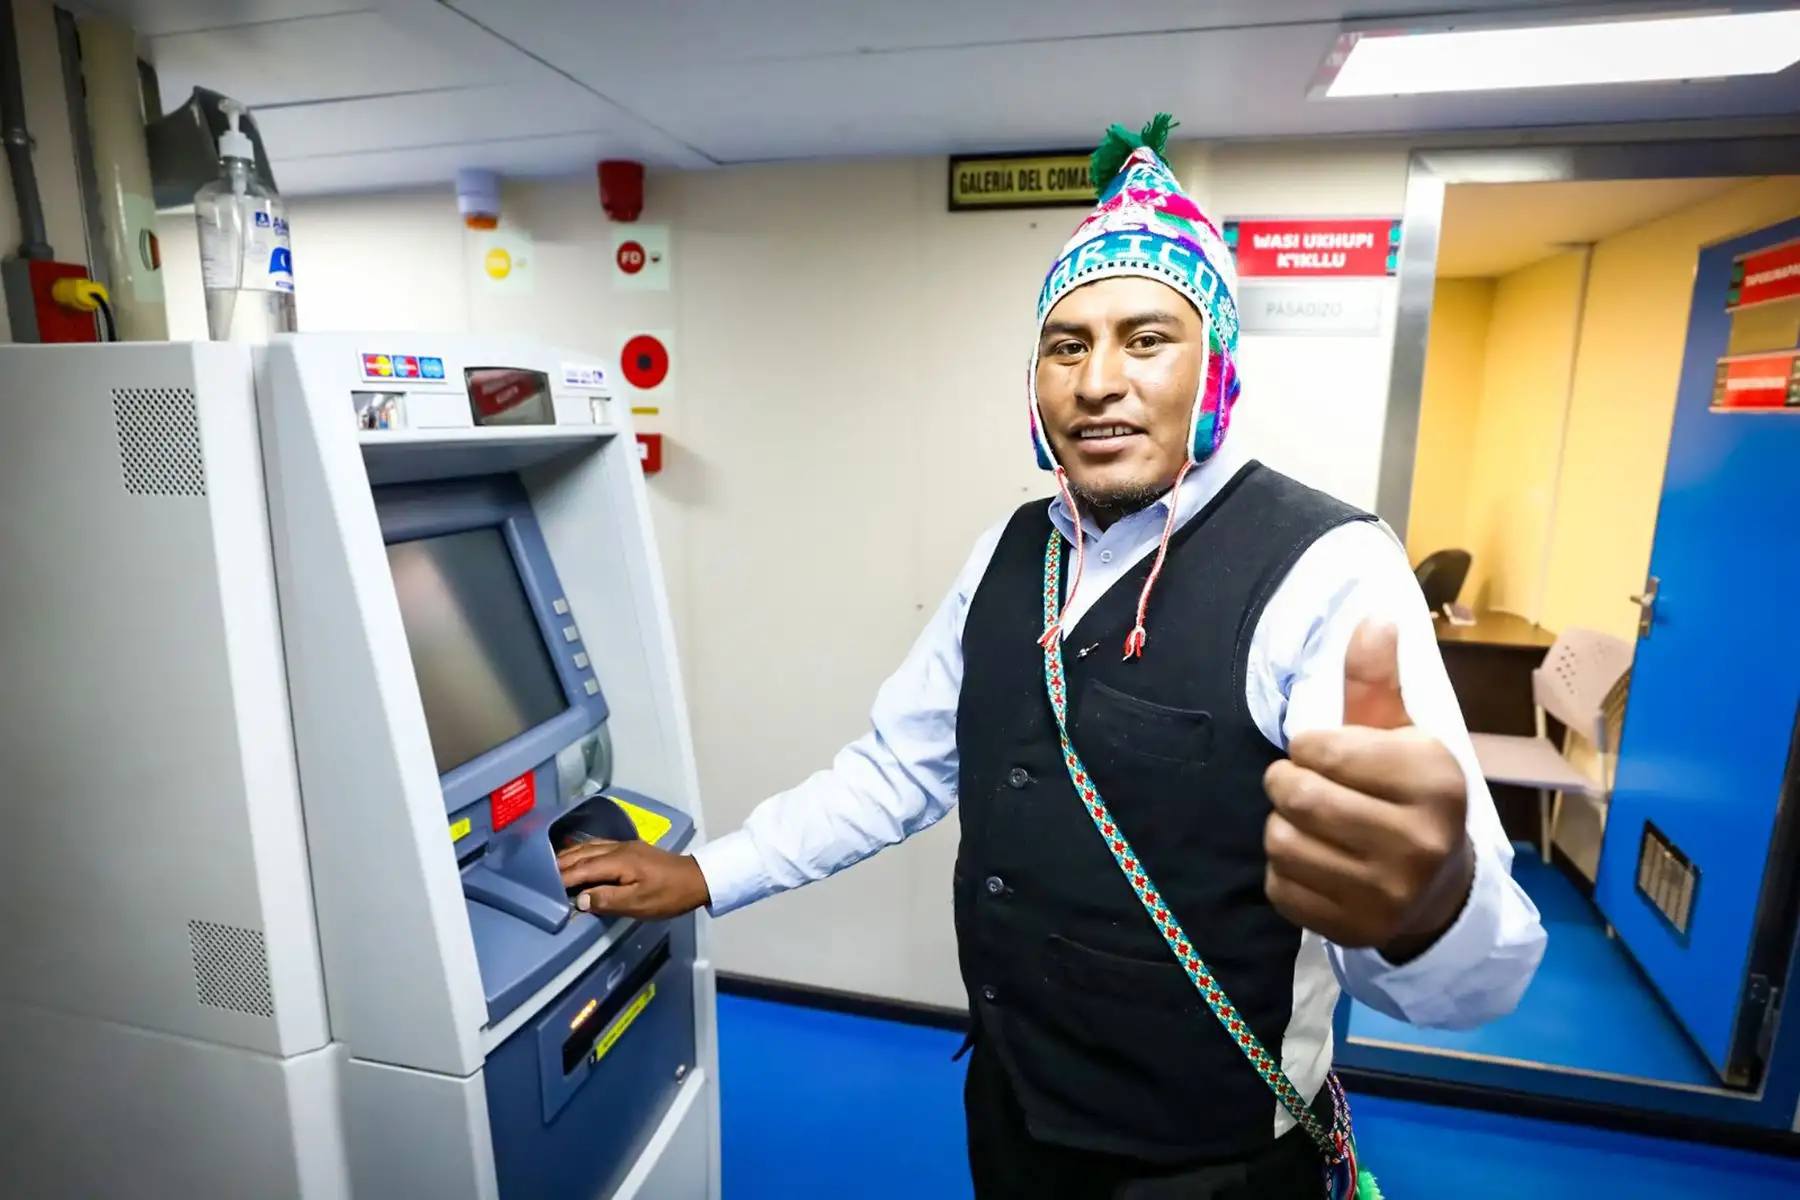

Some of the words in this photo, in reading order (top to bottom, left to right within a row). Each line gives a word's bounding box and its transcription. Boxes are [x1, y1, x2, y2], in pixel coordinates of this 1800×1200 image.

[1019, 168, 1042, 191] DEL
[1253, 233, 1299, 249] WASI
[1303, 232, 1374, 248] UKHUPI
